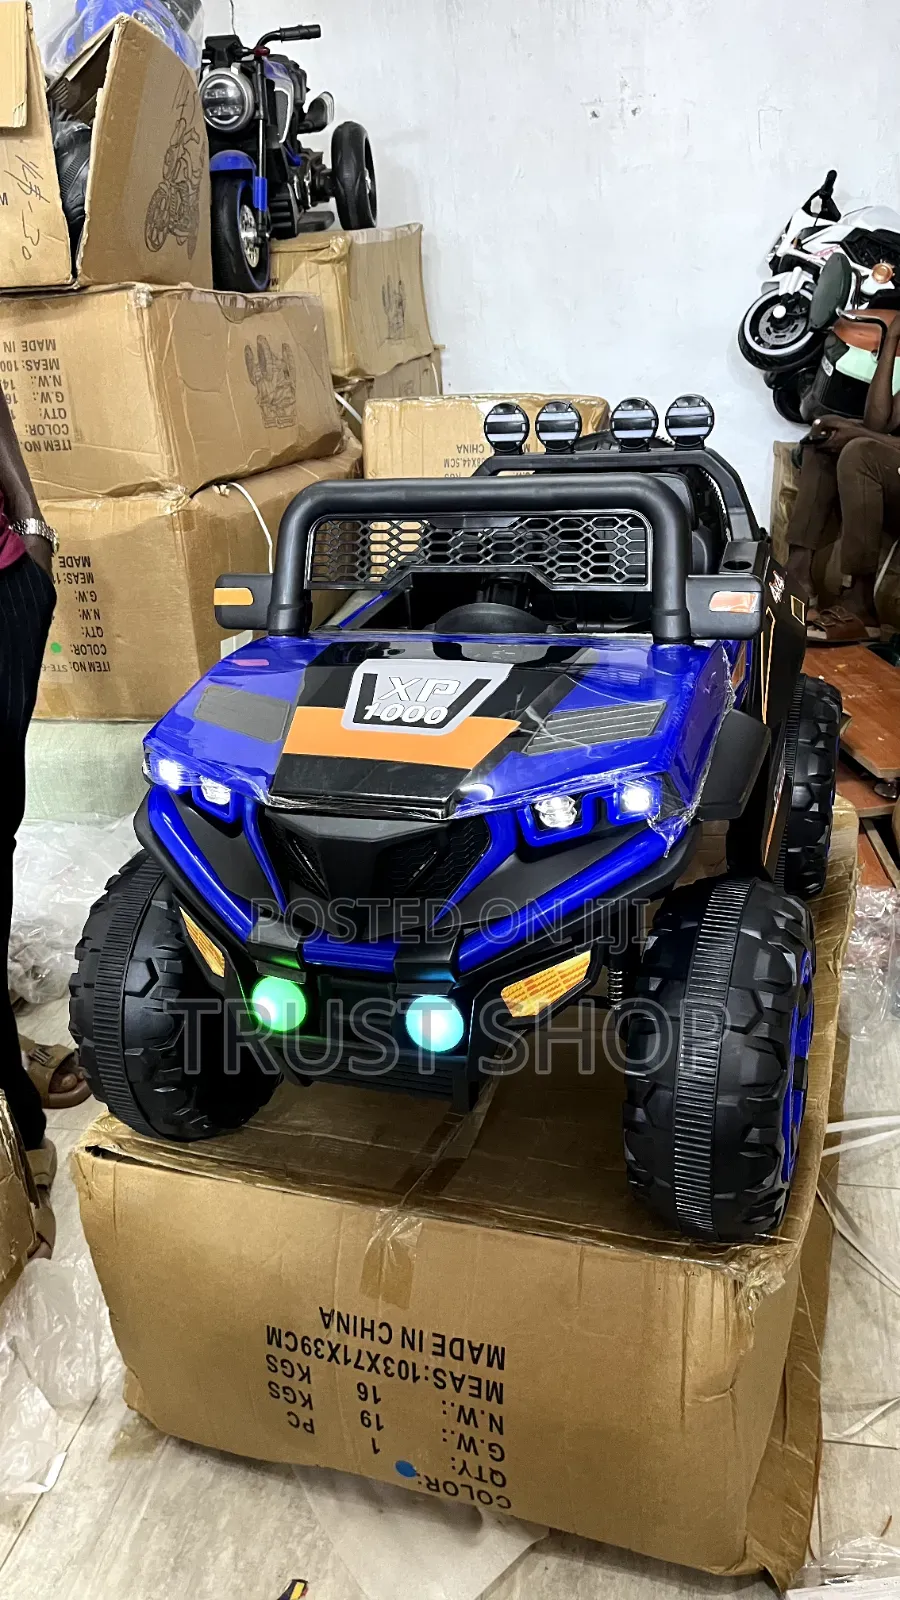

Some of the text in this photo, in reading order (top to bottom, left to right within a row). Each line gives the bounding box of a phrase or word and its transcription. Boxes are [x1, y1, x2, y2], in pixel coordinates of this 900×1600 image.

[3, 339, 57, 353] MADE IN
[21, 358, 60, 372] MEAS:
[39, 408, 67, 420] QTY:
[25, 423, 69, 436] COLOR:
[43, 439, 72, 452] ITEM
[456, 444, 485, 454] CHINA
[58, 556, 91, 568] MADE
[81, 626, 104, 638] QTY:
[70, 644, 107, 656] COLOR:
[69, 661, 87, 673] NO:
[88, 661, 111, 673] ITEM
[378, 676, 461, 703] XP
[363, 702, 449, 725] 1000
[319, 1306, 506, 1371] MADE IN CHINA
[265, 1353, 504, 1436] N.W.: 16 KGS
[267, 1380, 506, 1463] G.W.: 19 KGS
[287, 1410, 507, 1488] QTY: 1 PC
[415, 1472, 512, 1510] COLOR:
